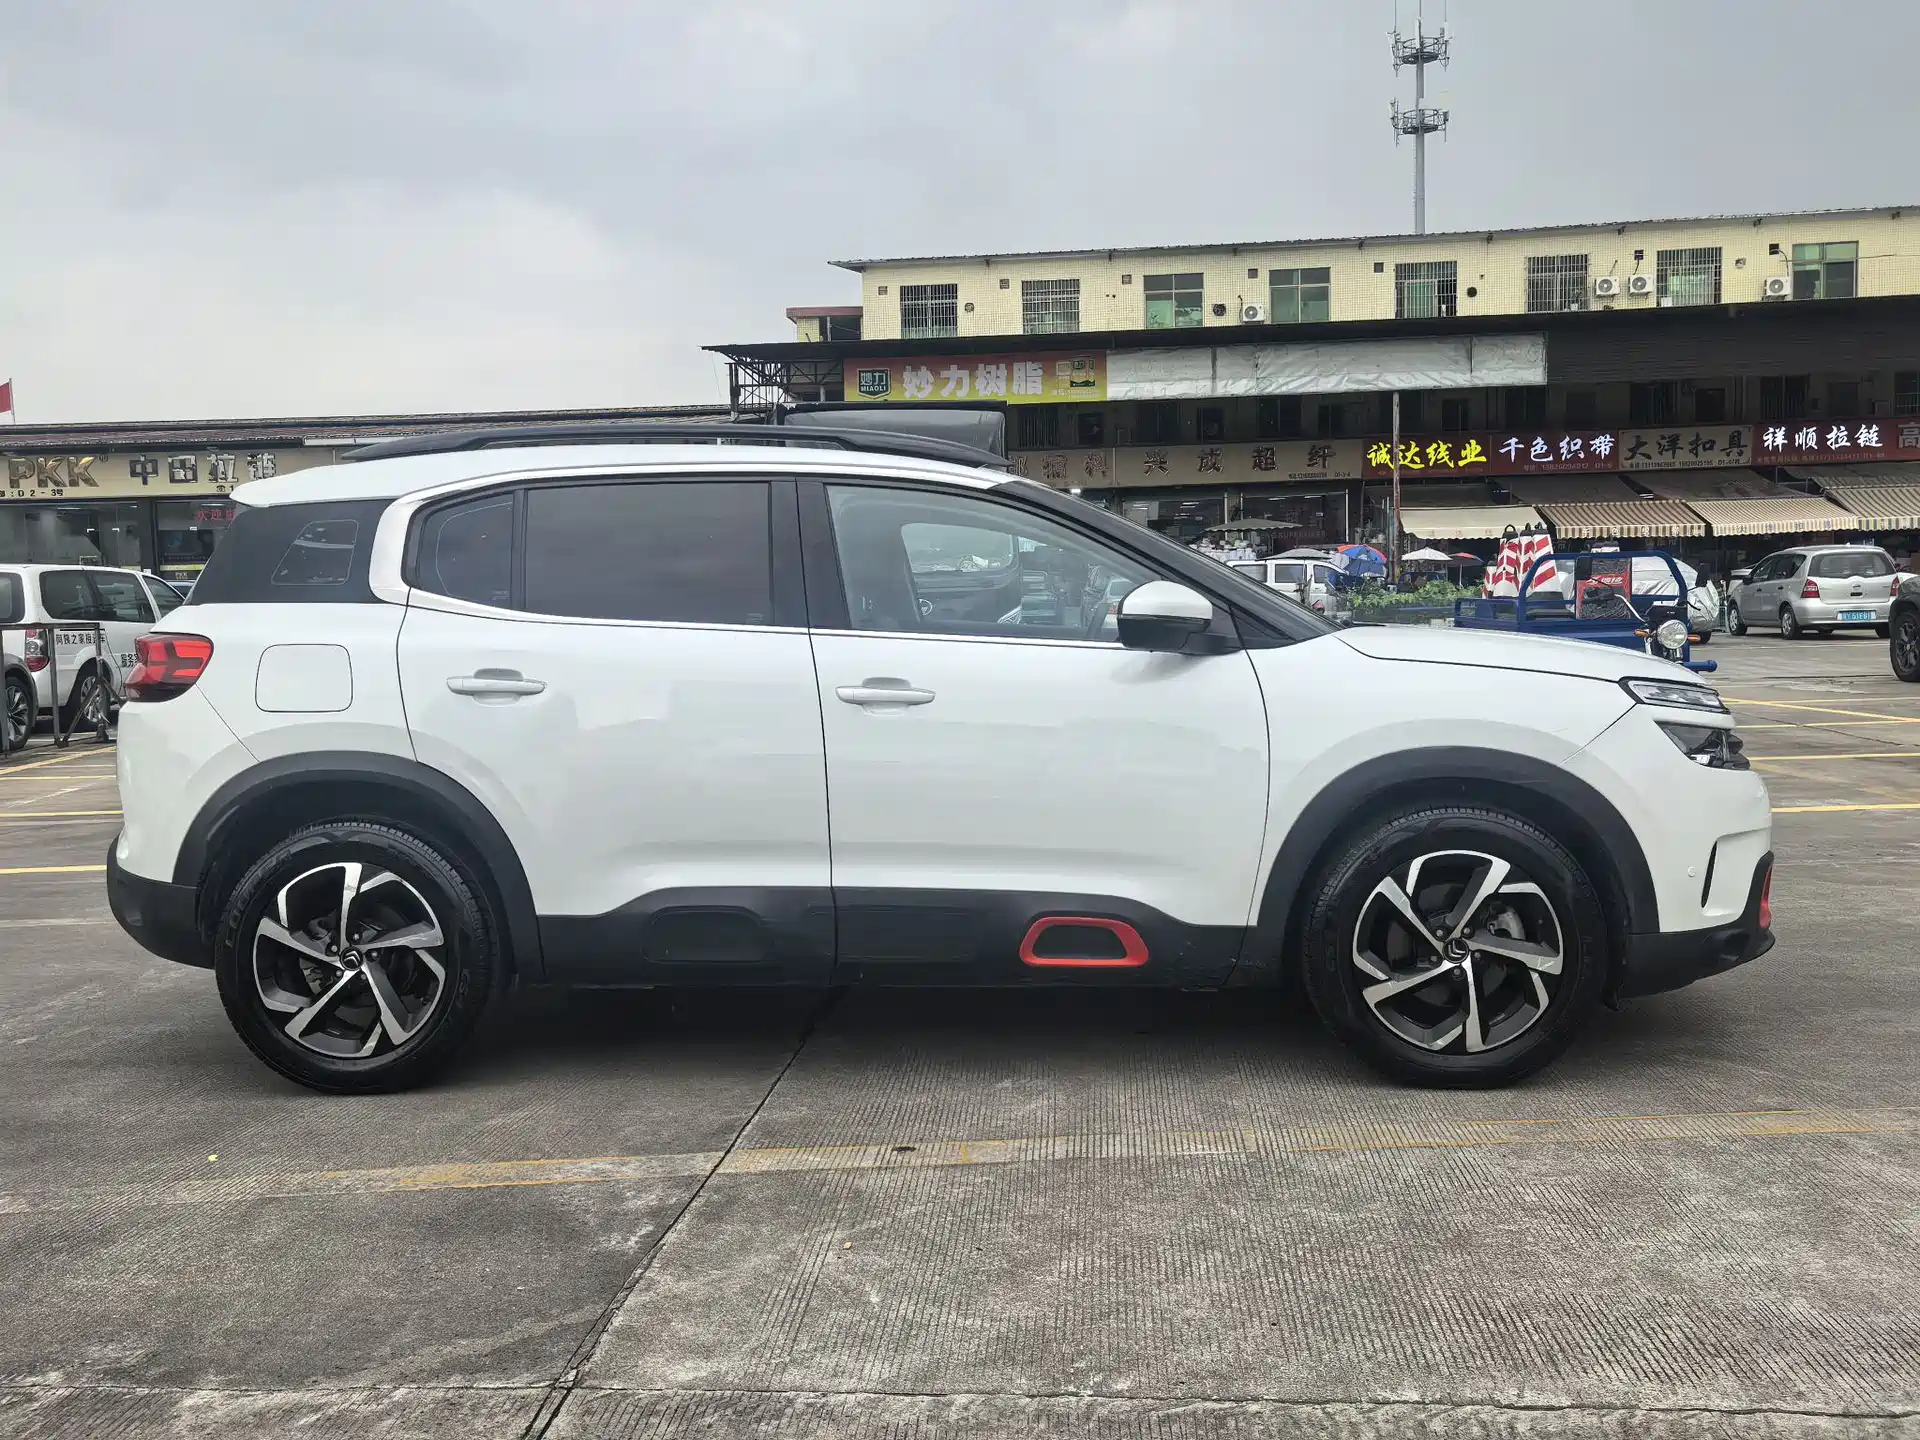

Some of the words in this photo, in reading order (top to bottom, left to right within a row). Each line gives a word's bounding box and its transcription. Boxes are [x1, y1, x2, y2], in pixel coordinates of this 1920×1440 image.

[860, 371, 886, 386] 妙力
[903, 361, 1043, 399] 妙力树脂
[1499, 434, 1616, 463] 千色织带
[1624, 430, 1748, 461] 大洋扣具
[1763, 423, 1883, 452] 祥顺拉链
[1366, 439, 1487, 469] 诚达线业
[8, 456, 99, 488] PKK
